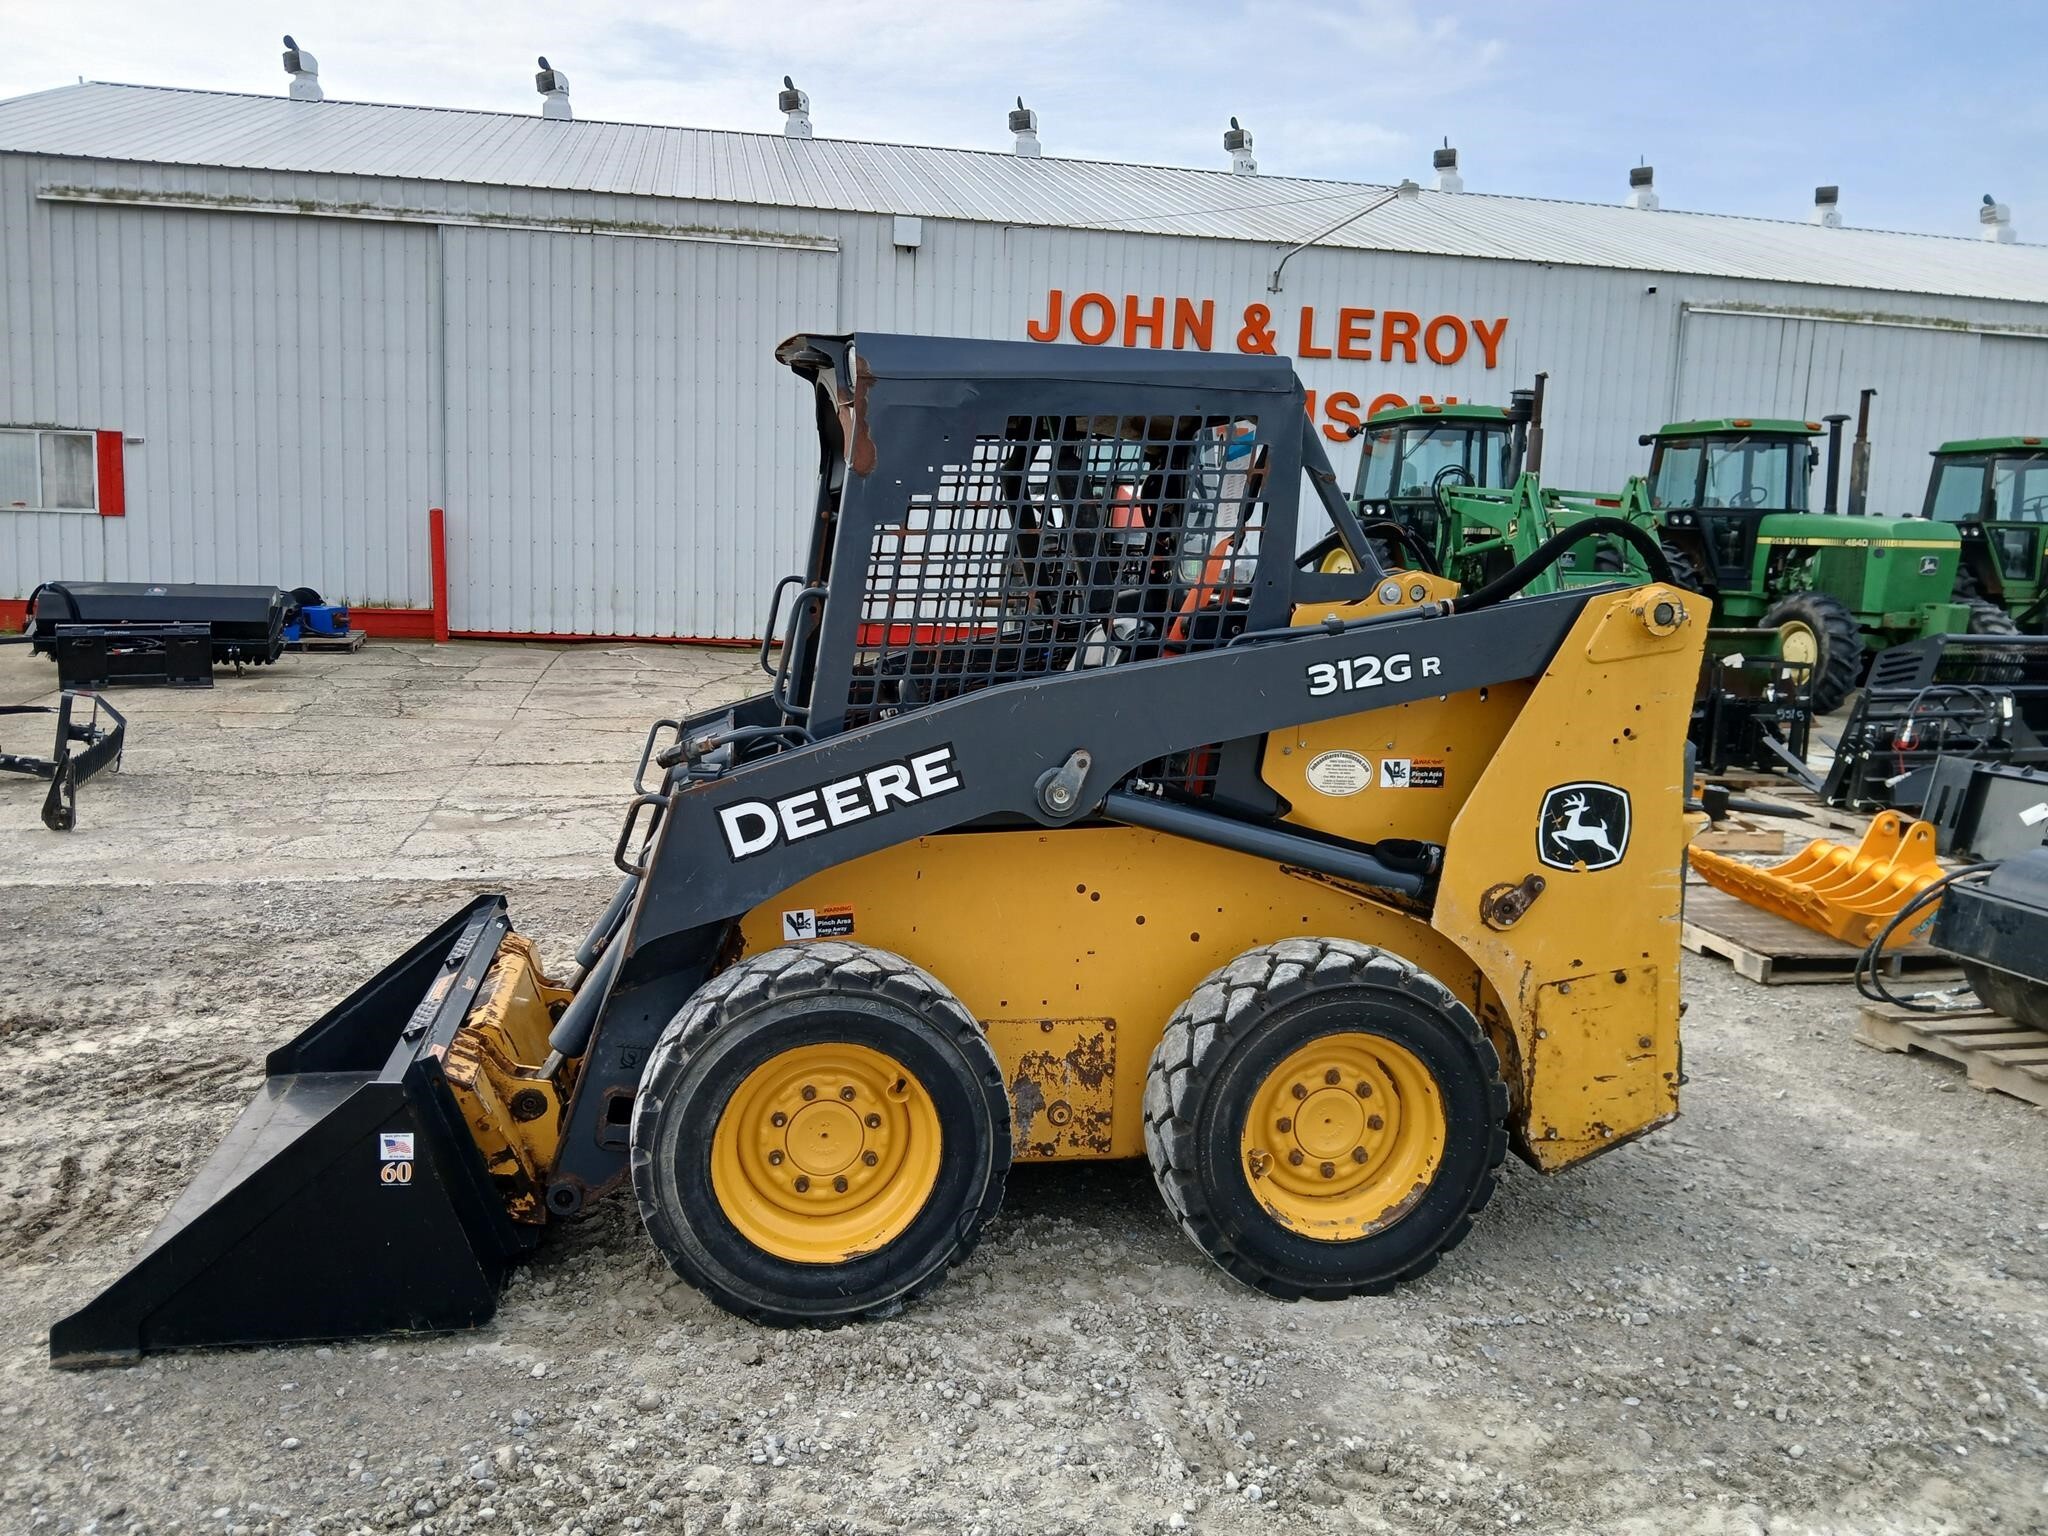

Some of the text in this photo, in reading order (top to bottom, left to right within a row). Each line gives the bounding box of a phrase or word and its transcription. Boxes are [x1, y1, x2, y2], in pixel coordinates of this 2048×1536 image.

[1027, 290, 1508, 369] JOHN & LEROY
[1308, 653, 1442, 695] 312G R
[719, 748, 959, 858] DEERE
[824, 905, 851, 913] WARNING
[785, 995, 932, 1034] GALAXY
[381, 1161, 412, 1183] 60
